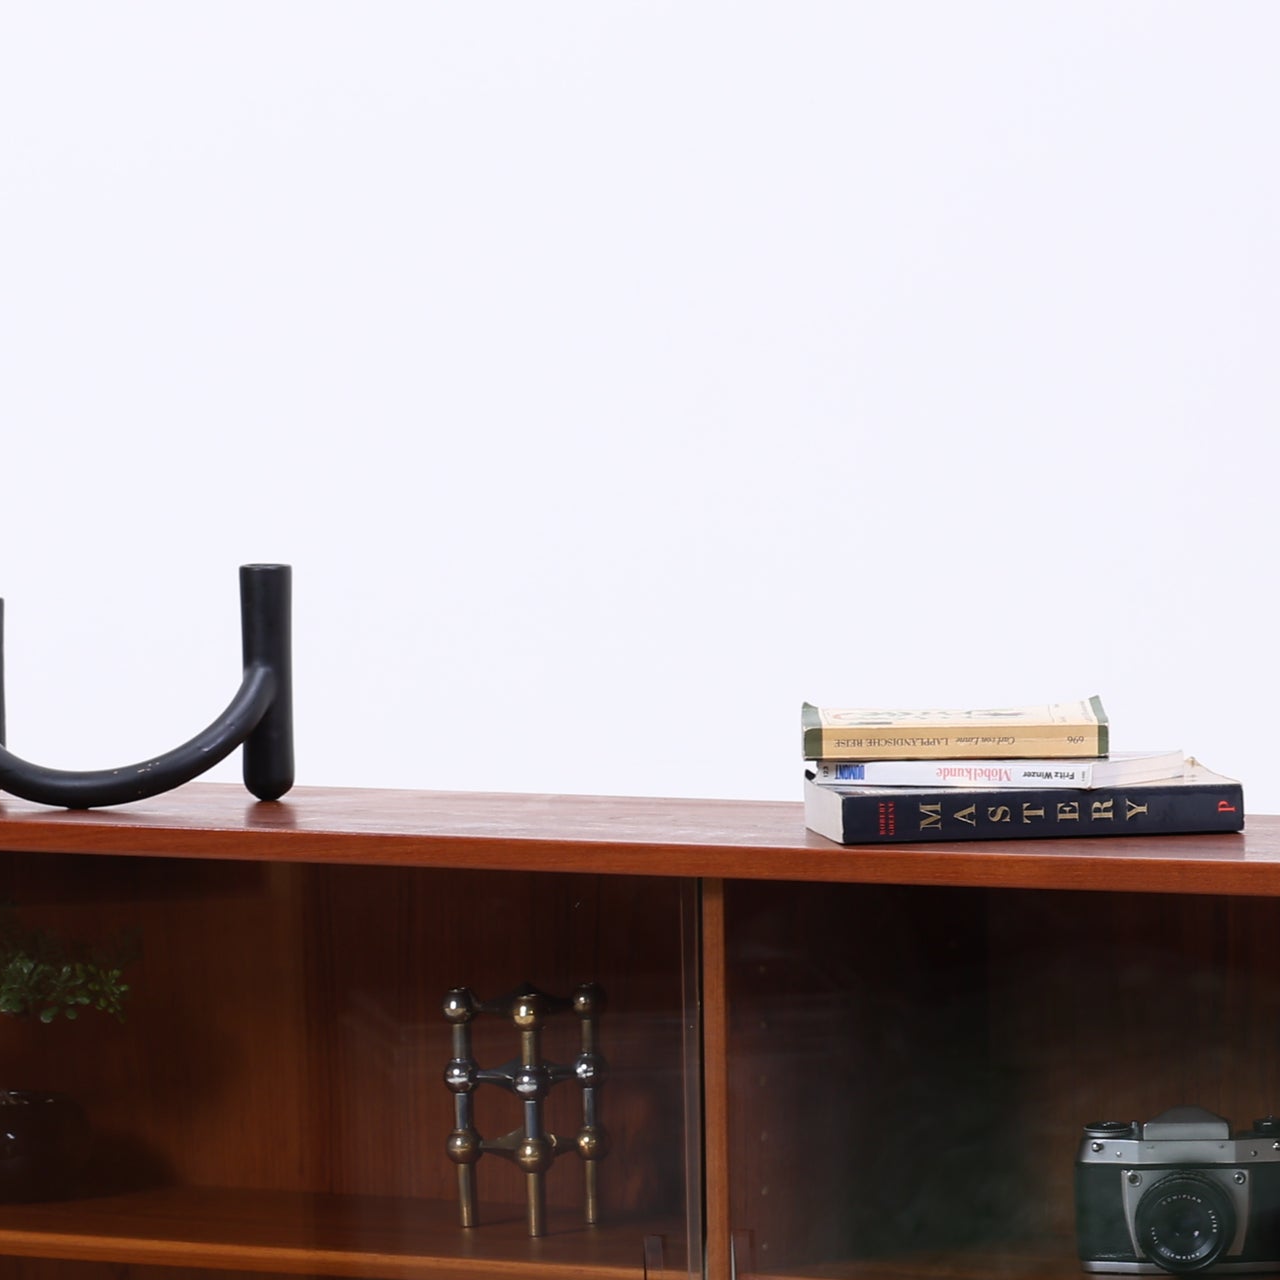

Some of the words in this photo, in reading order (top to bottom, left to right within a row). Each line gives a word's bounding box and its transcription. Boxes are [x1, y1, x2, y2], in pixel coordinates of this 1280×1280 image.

[834, 738, 863, 748] REISE
[981, 736, 996, 745] von
[997, 735, 1016, 746] Carl
[1067, 735, 1085, 745] 696
[834, 764, 865, 780] DUMONT
[936, 767, 1012, 782] Möbelkunde
[1022, 770, 1053, 780] Winzer
[1054, 770, 1076, 780] Fritz
[919, 798, 1148, 831] MASTERY
